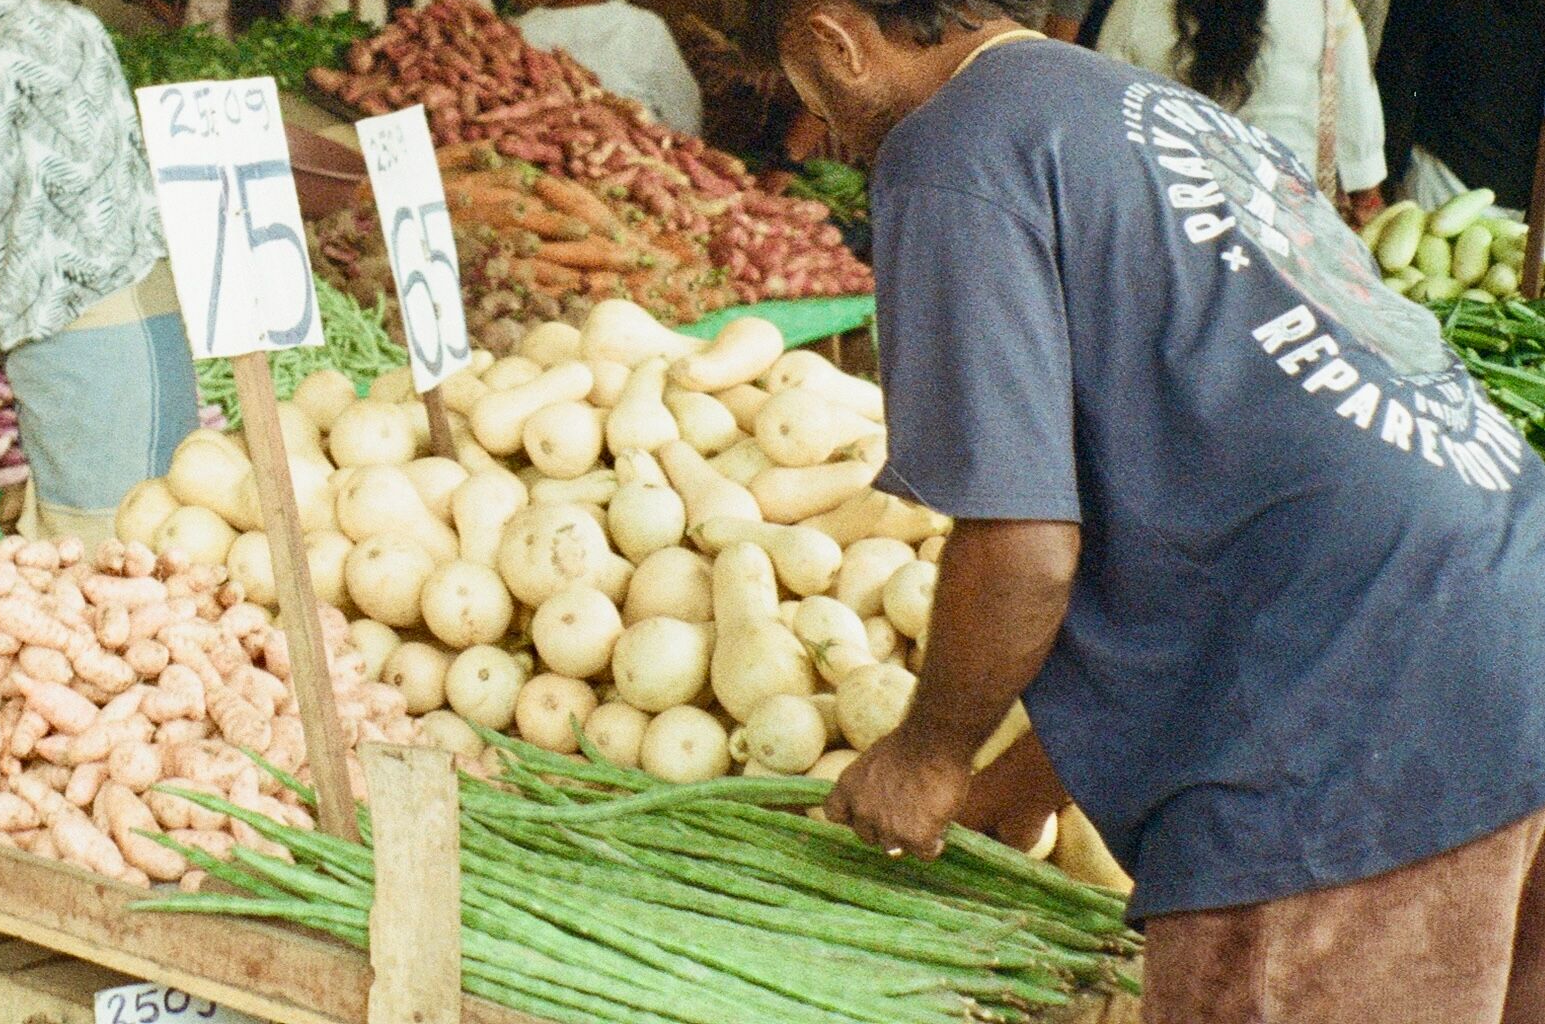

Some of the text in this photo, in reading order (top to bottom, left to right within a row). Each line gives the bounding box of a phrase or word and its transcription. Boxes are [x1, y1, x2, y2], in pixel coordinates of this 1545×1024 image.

[156, 158, 313, 354] 75
[1152, 126, 1237, 244] PRAY
[391, 206, 470, 376] 65
